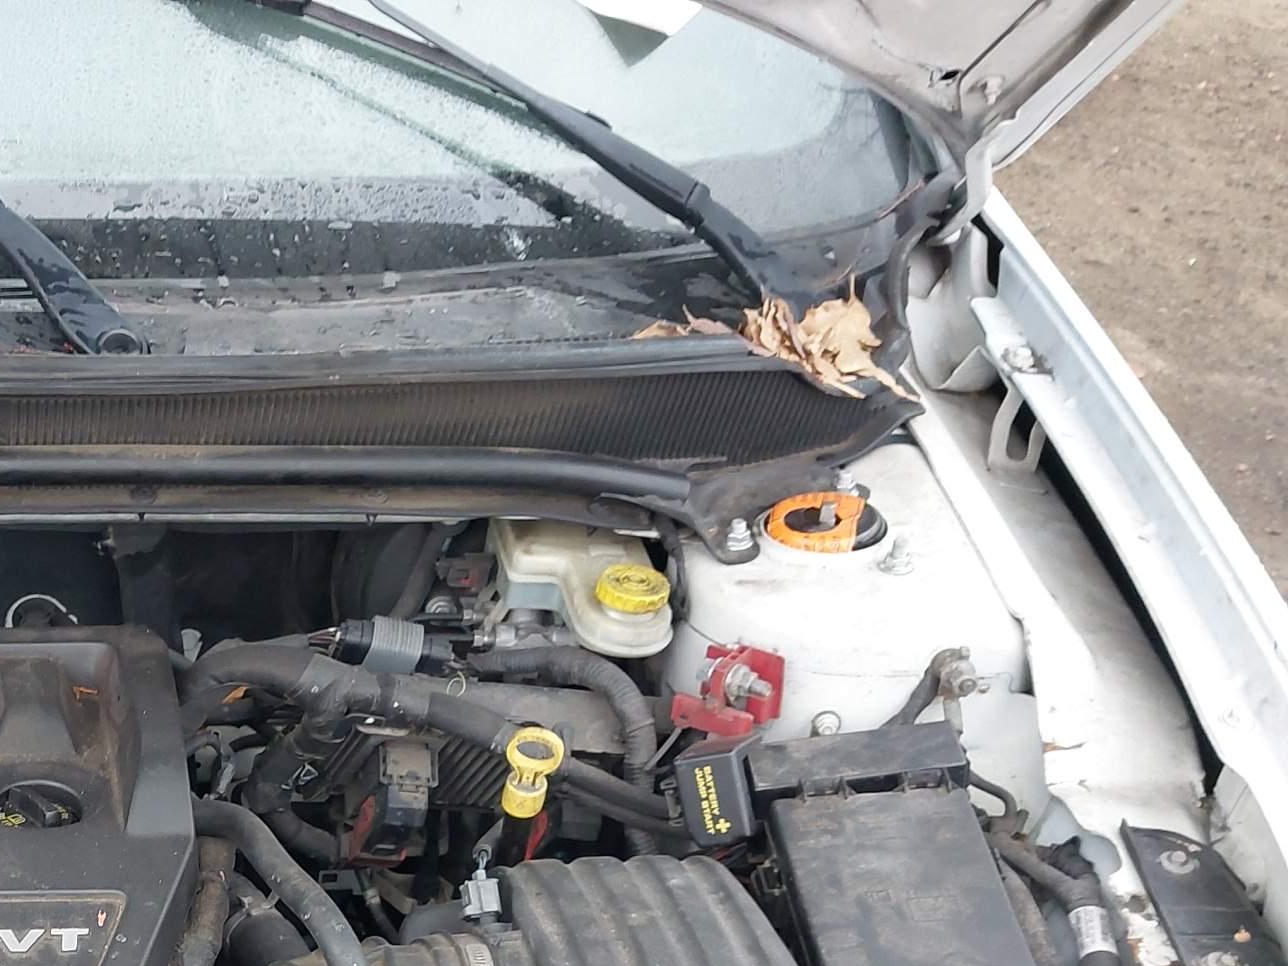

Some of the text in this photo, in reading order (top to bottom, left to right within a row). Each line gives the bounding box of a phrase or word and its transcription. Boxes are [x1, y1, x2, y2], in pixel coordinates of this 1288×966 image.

[694, 767, 716, 835] JUMP START
[703, 765, 720, 816] BATTERY
